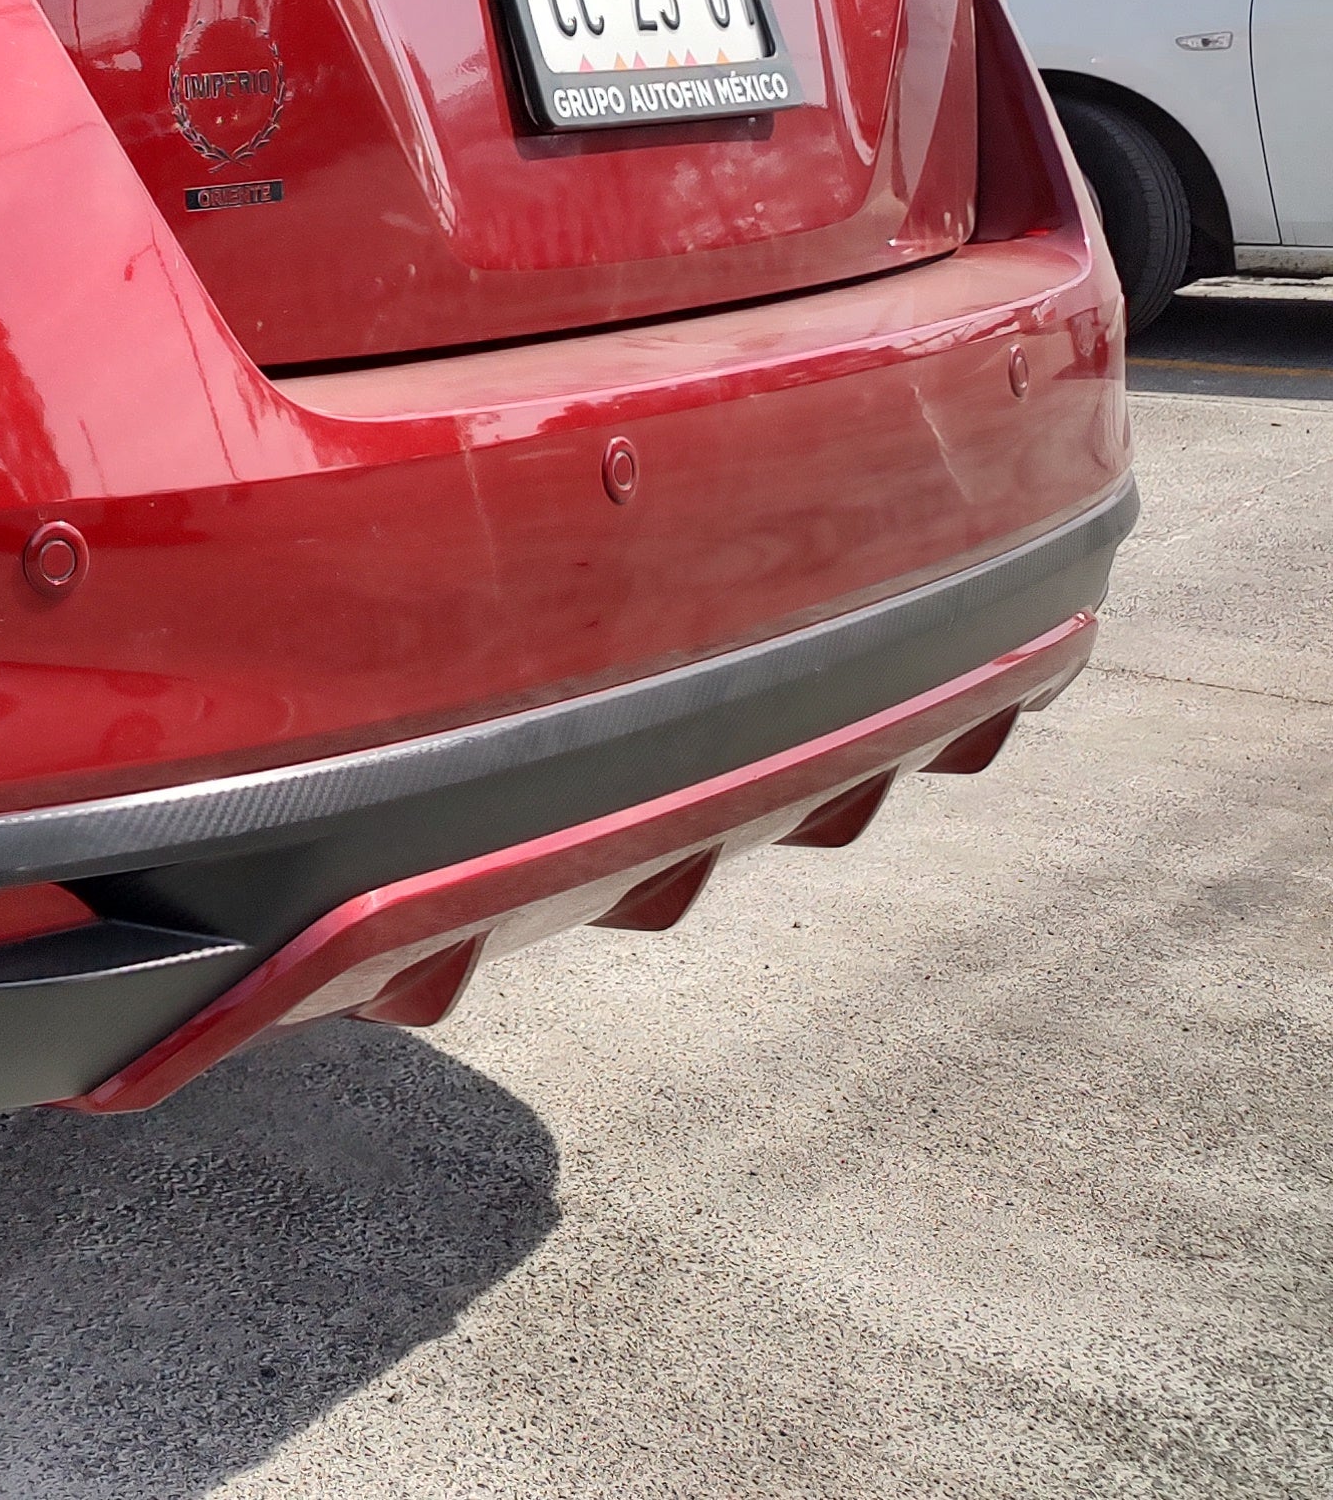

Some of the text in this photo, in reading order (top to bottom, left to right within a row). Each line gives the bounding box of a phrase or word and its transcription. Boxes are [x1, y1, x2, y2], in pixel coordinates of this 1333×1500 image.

[183, 69, 272, 100] IMPERIO
[553, 70, 790, 119] GRUPO AUTOFIN MÉXICO
[197, 183, 272, 208] ORIENTE
